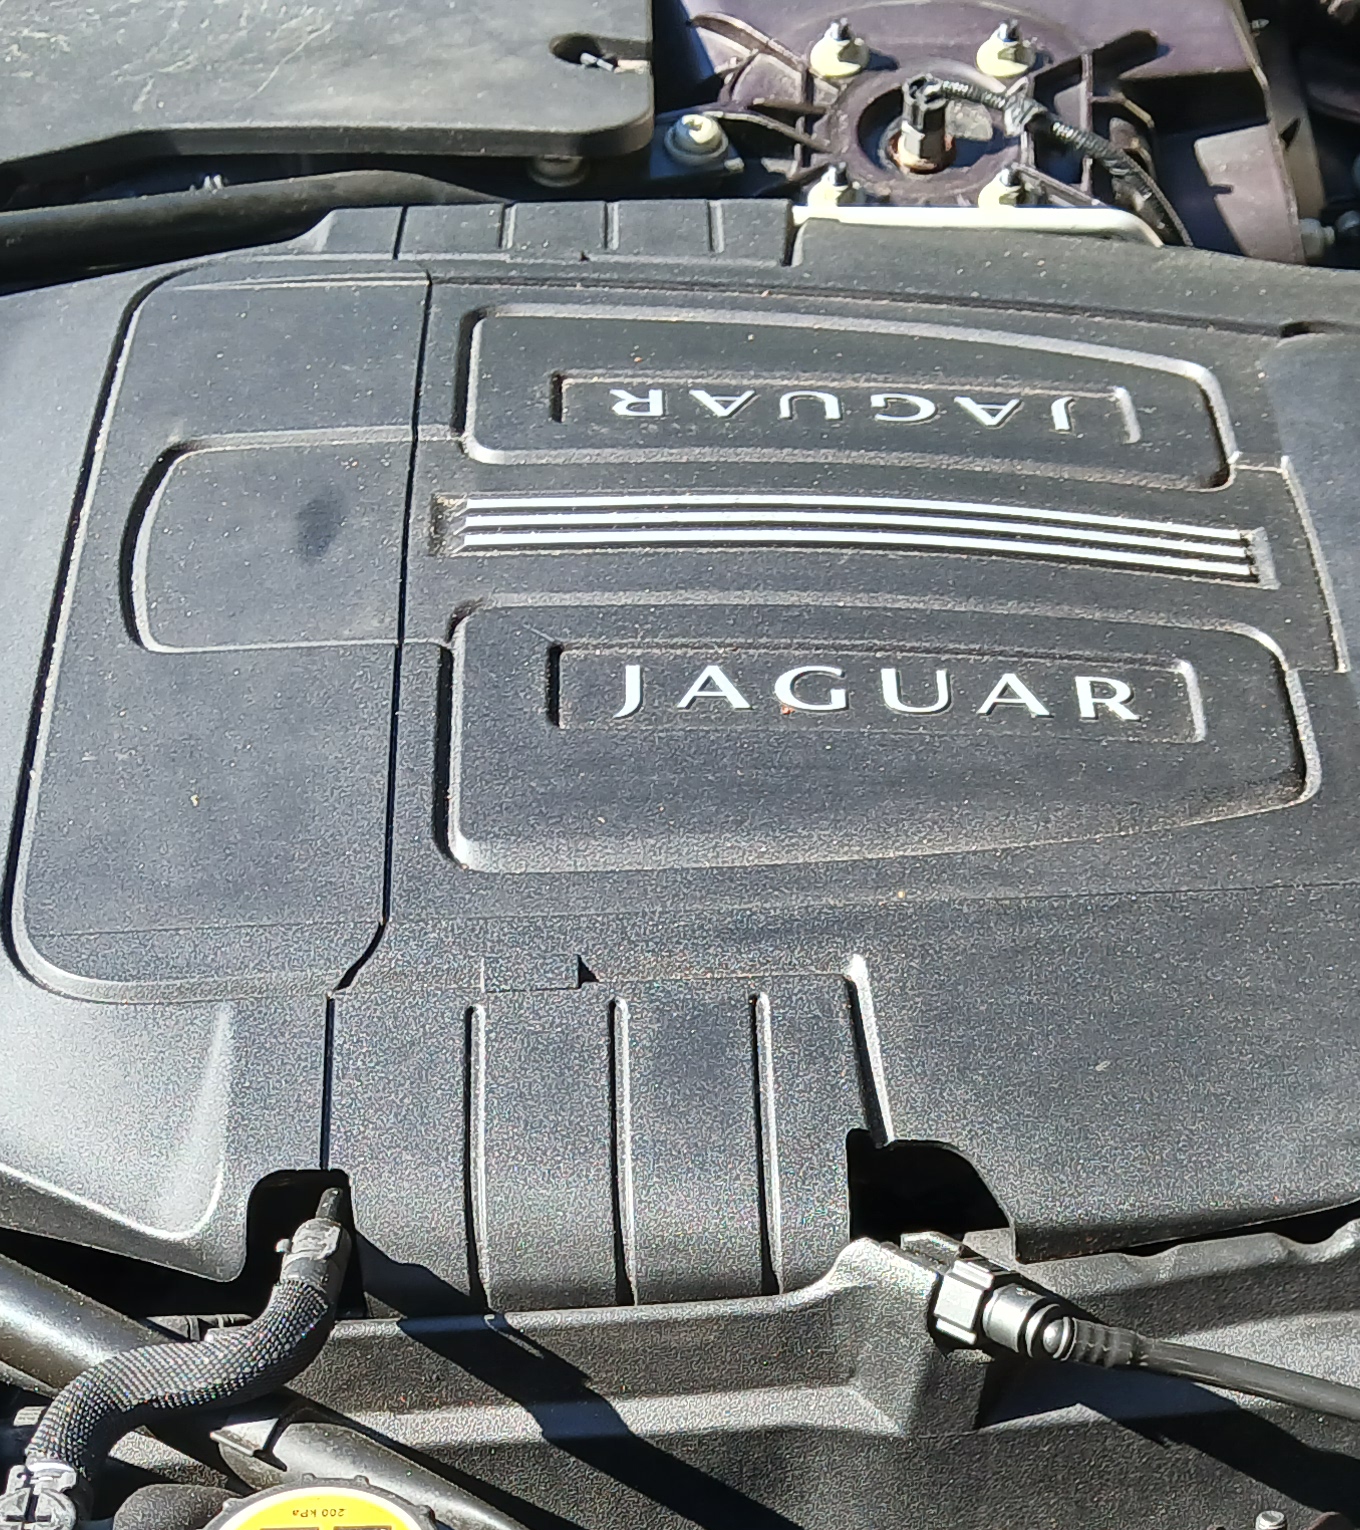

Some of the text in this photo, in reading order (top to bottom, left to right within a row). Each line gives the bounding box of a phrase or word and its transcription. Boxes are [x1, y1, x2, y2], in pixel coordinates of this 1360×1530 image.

[608, 388, 1074, 432] JAGUAR
[612, 663, 1142, 722] JAGUAR
[292, 1508, 345, 1518] 200 kPa
